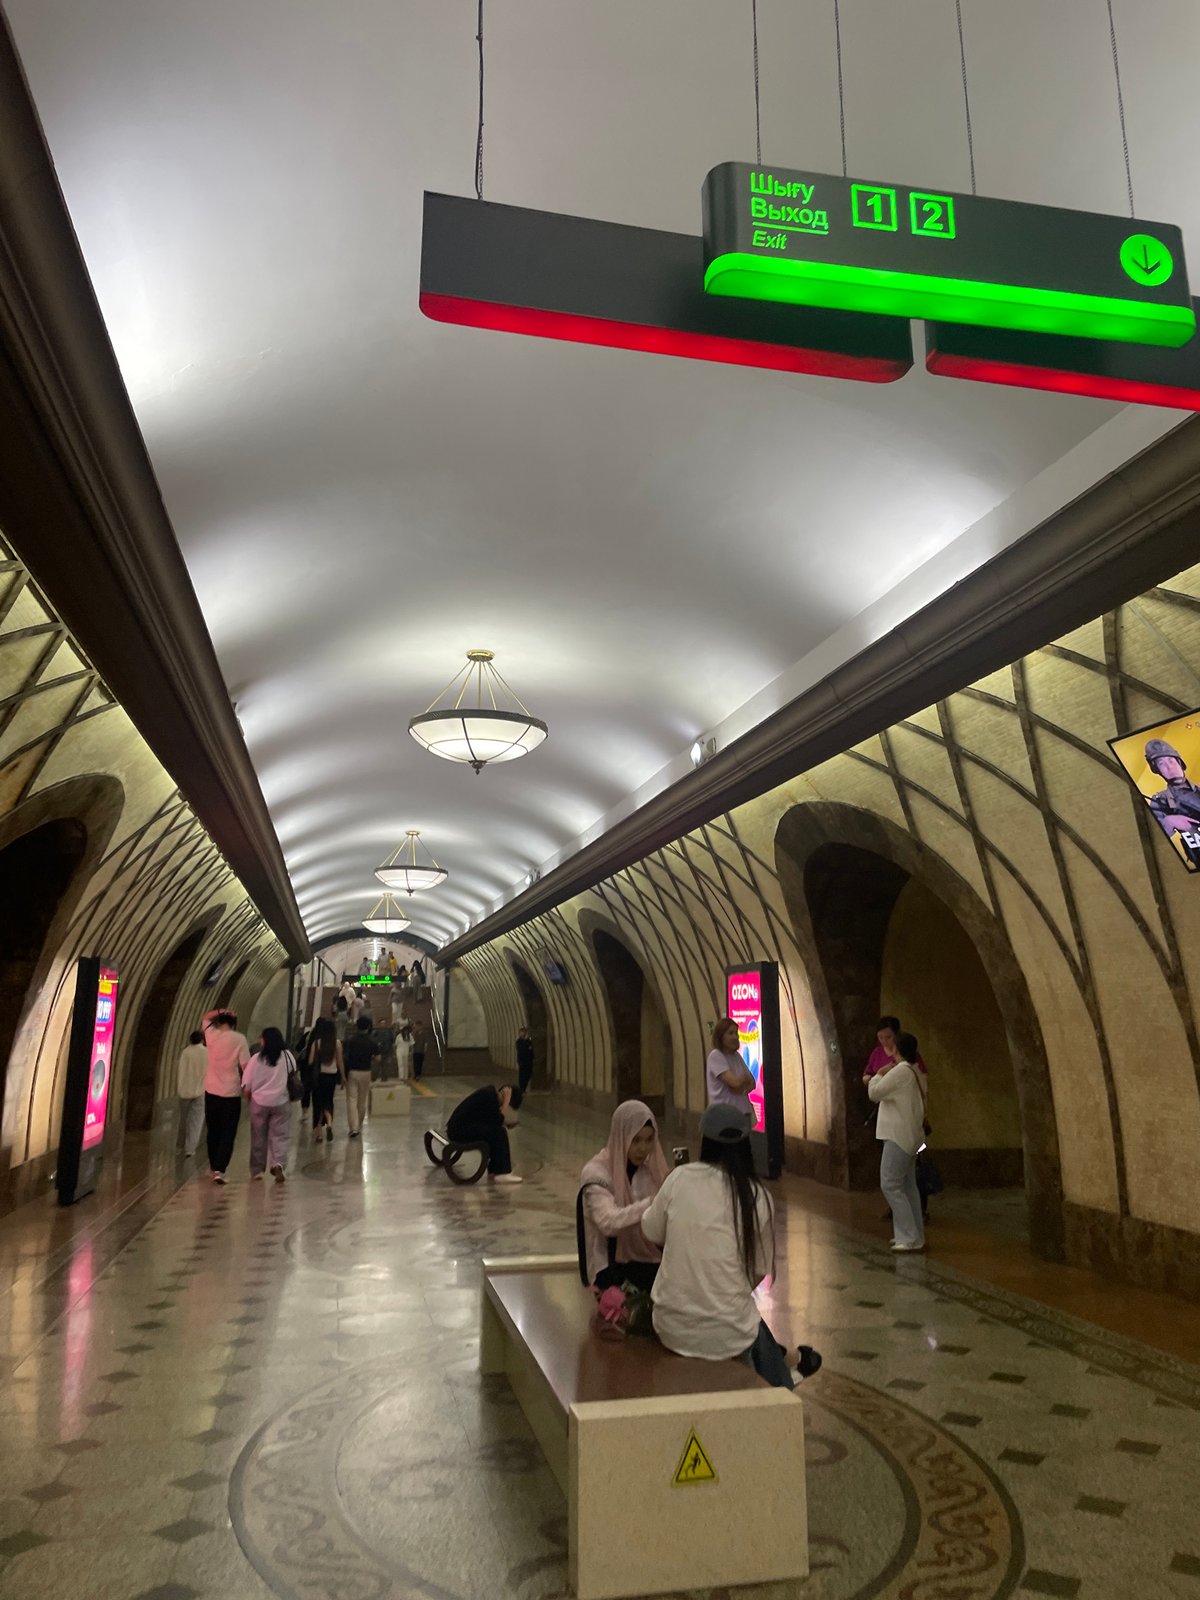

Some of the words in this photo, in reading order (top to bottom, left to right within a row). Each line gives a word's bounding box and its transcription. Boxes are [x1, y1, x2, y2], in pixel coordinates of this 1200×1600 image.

[751, 172, 815, 204] Шығу
[751, 196, 829, 230] Выход
[866, 193, 883, 223] 1
[922, 201, 944, 231] 2
[752, 230, 788, 250] Exit
[732, 983, 754, 1001] OZON
